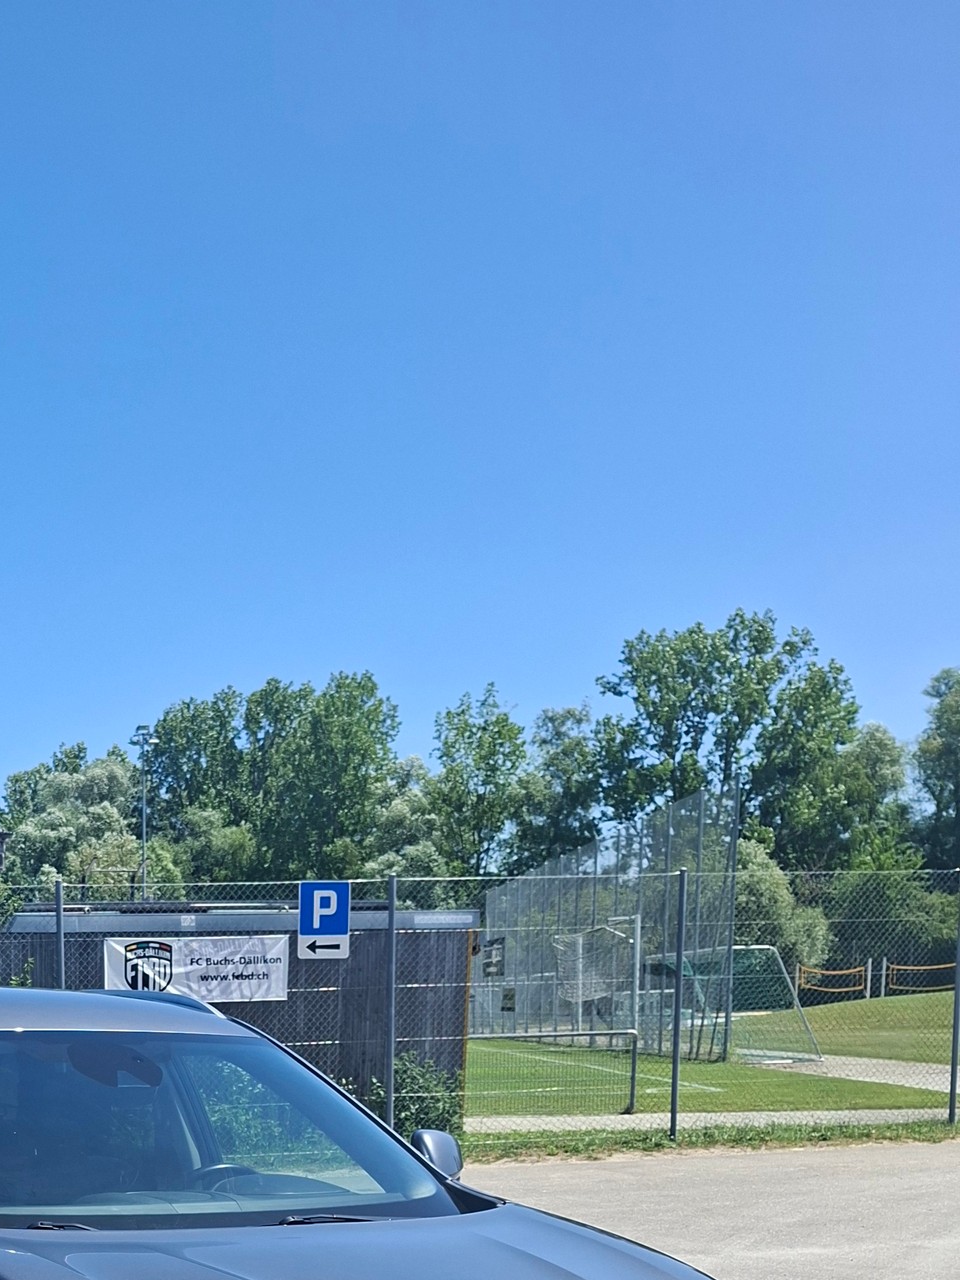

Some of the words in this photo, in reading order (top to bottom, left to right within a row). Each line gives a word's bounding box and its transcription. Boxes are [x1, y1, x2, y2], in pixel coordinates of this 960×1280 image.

[313, 890, 338, 929] P
[190, 957, 203, 966] FC
[206, 956, 282, 966] Buchs-Dällikon
[200, 971, 269, 981] www.fcbd.ch
